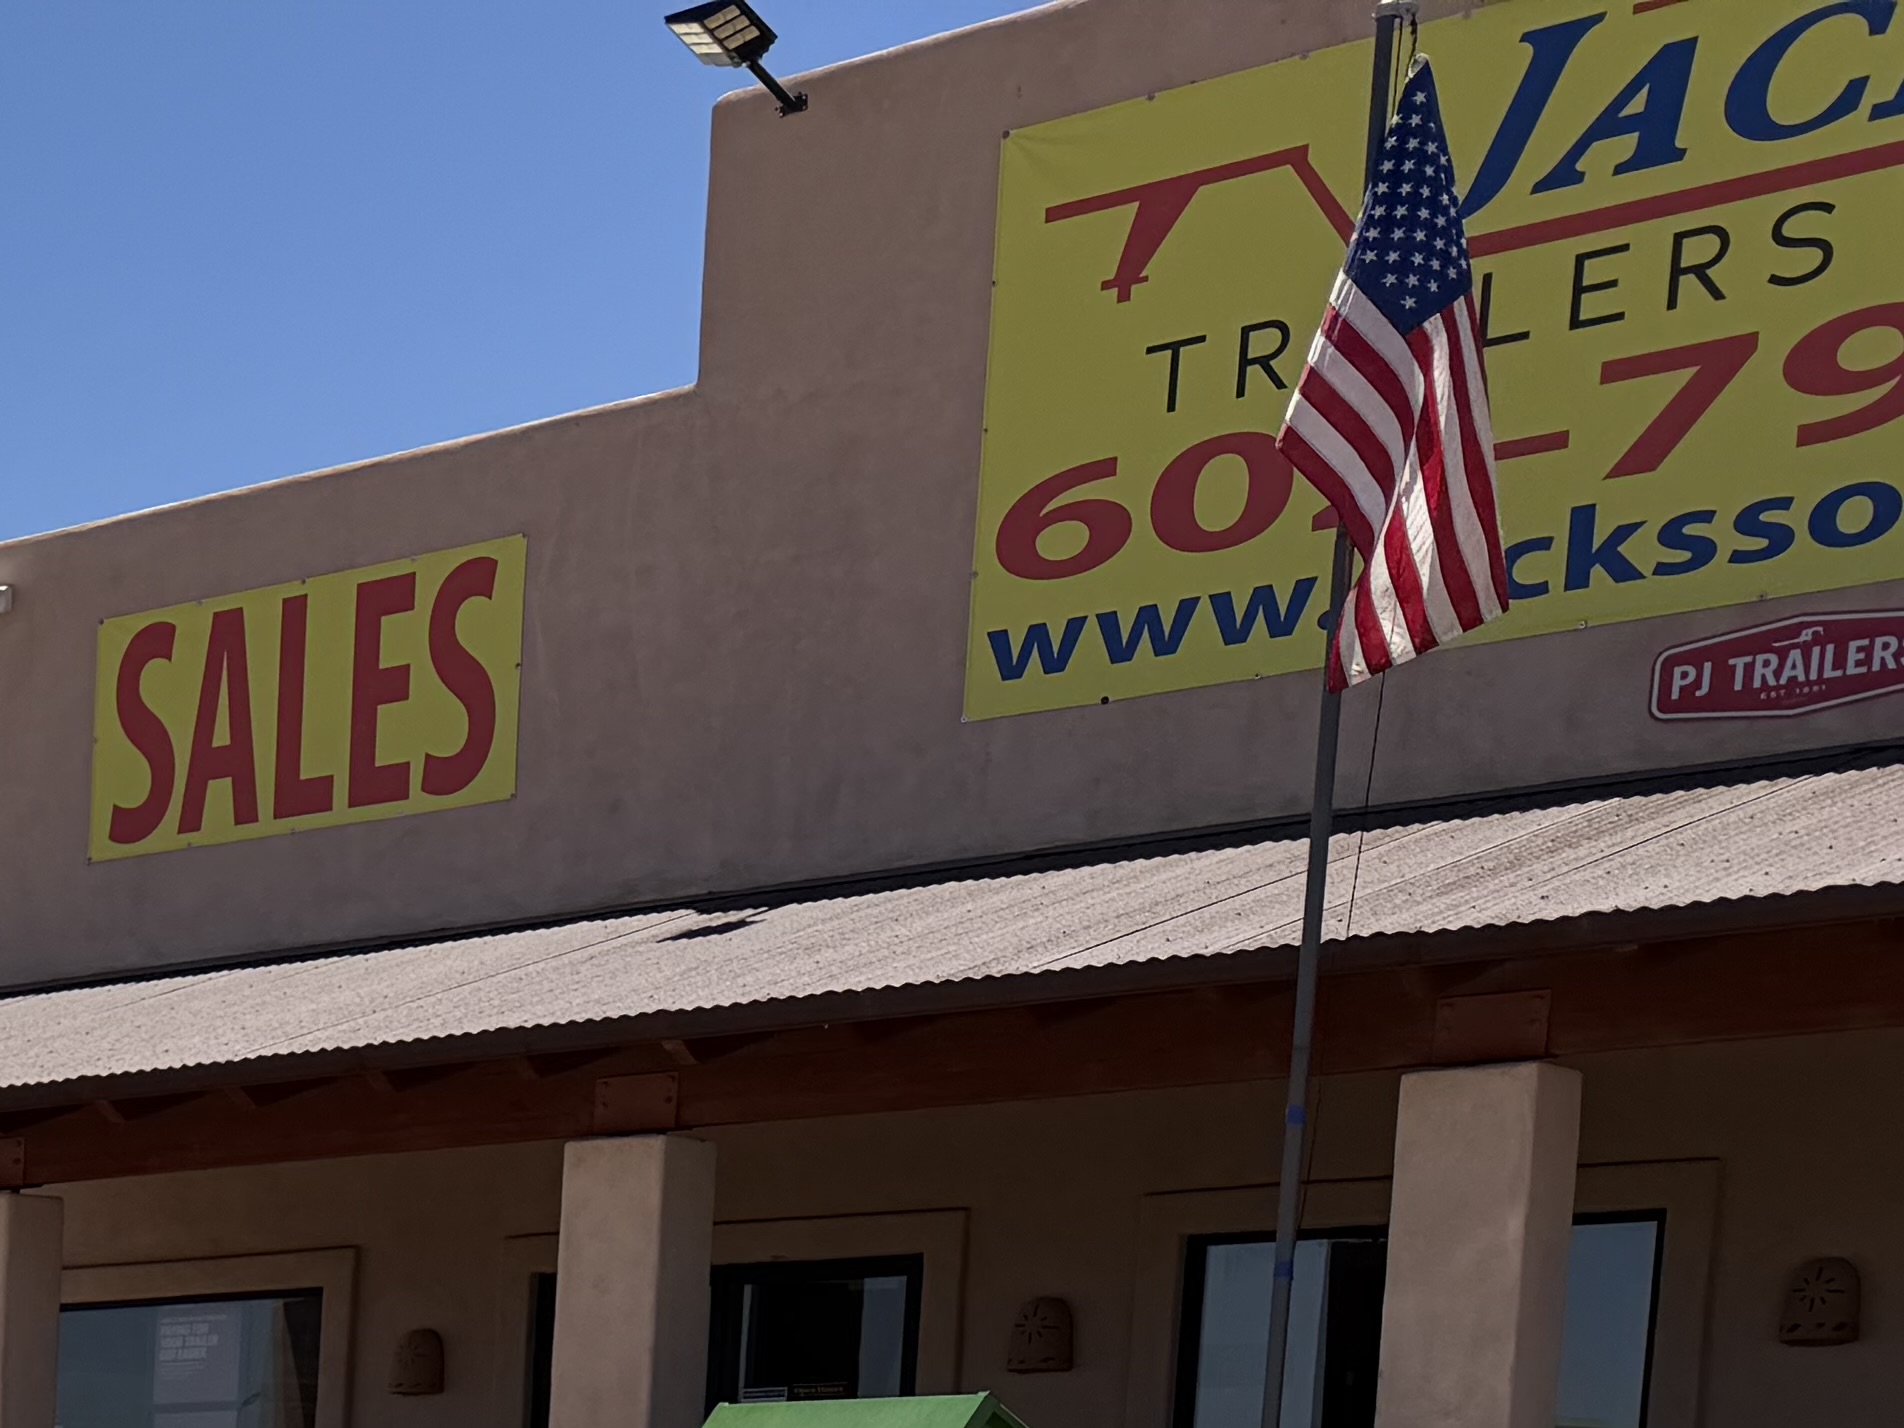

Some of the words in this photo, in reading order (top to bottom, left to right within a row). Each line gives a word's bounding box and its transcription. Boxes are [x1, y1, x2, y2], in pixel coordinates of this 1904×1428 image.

[1458, 0, 1904, 220] JAC
[1145, 201, 1836, 413] TRLERS
[995, 301, 1904, 581] 60-79
[987, 481, 1903, 682] www.cksso
[1671, 661, 1712, 700] PJ
[1728, 634, 1904, 691] TRAILER
[108, 556, 499, 844] SALES
